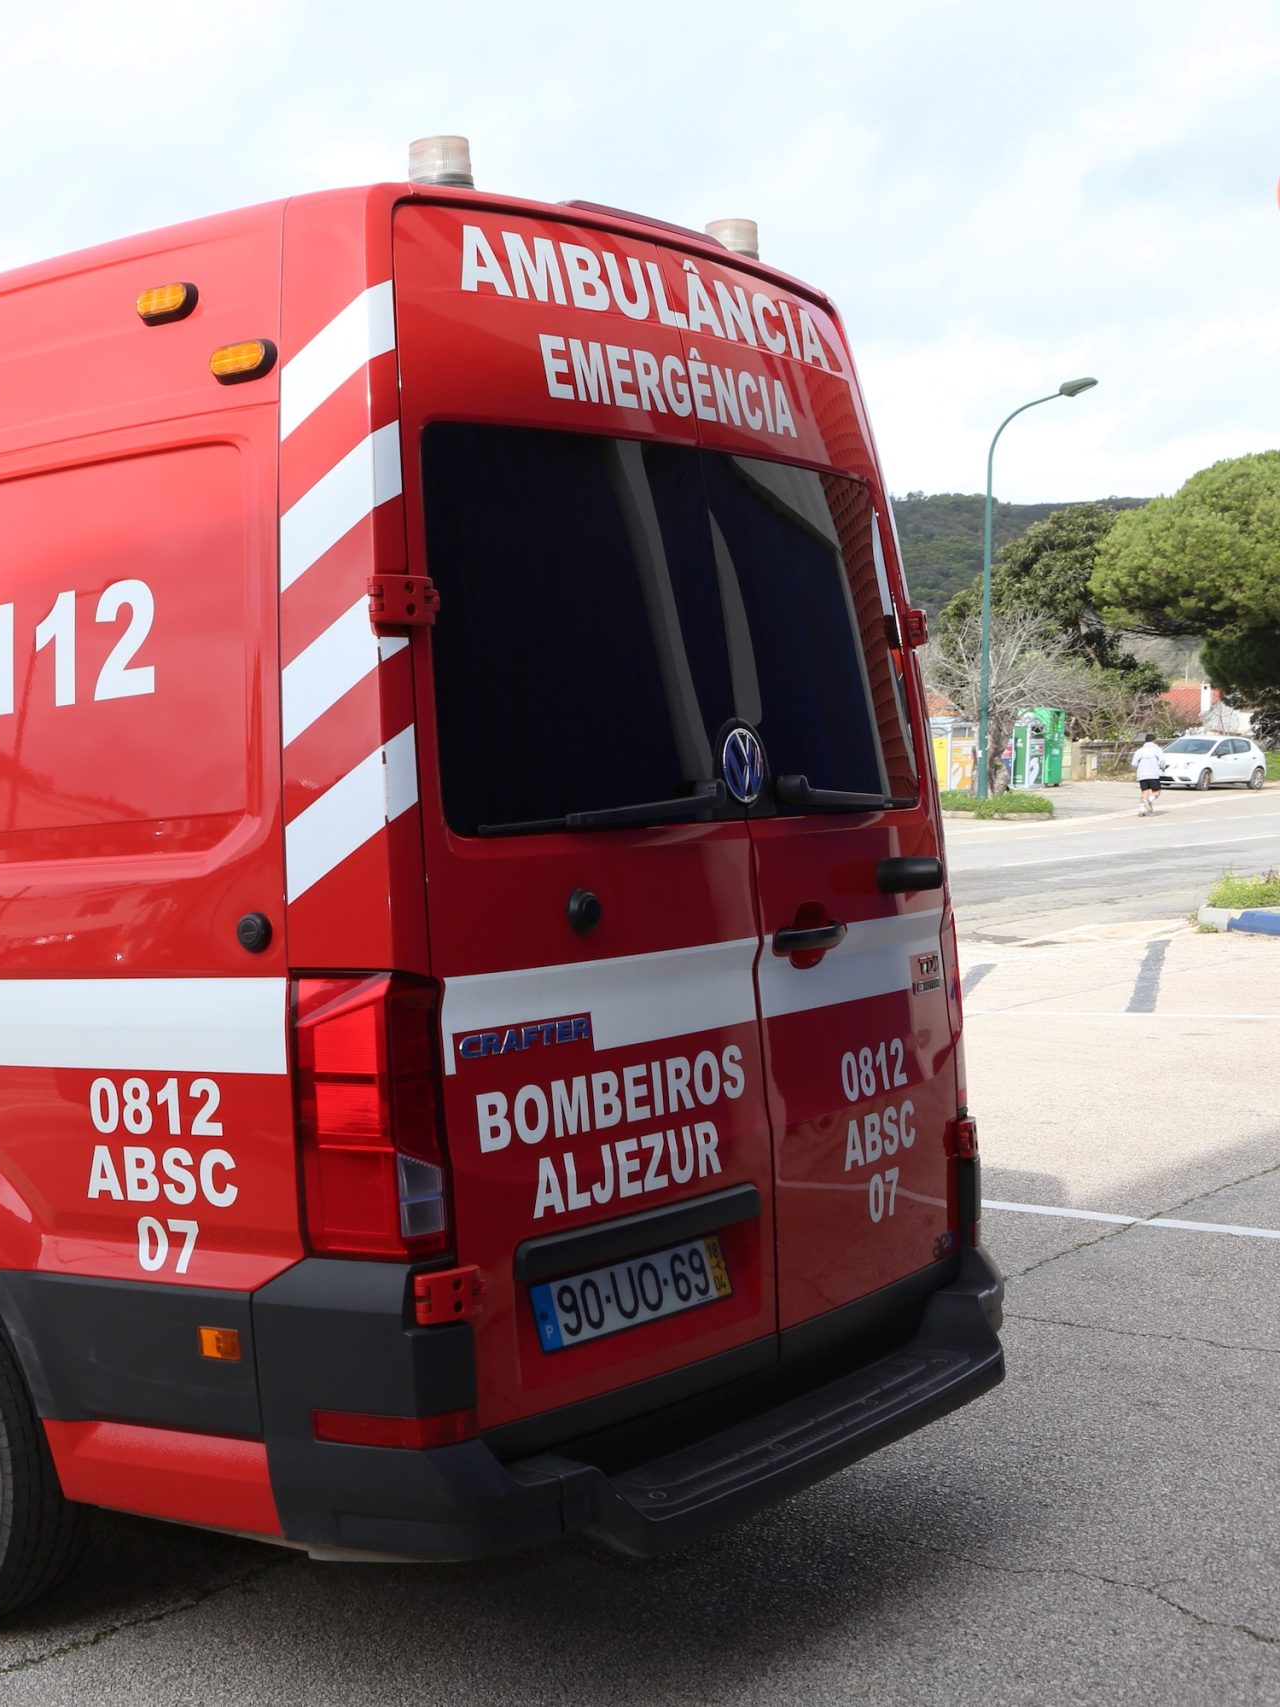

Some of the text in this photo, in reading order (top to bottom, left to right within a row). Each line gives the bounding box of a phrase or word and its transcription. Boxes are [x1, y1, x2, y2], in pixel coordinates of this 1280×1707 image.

[460, 223, 830, 370] AMBULÂNCIA
[538, 333, 798, 439] EMERGÊNCIA
[458, 1017, 590, 1059] CRAFTER
[841, 1037, 908, 1102] 0812
[89, 1076, 224, 1137] 0812
[475, 1044, 745, 1154] BOMBEIROS
[844, 1099, 916, 1172] ABSC
[87, 1144, 239, 1208] ABSC
[532, 1121, 722, 1219] ALJEZUR
[869, 1166, 899, 1223] 07
[137, 1215, 200, 1275] 07
